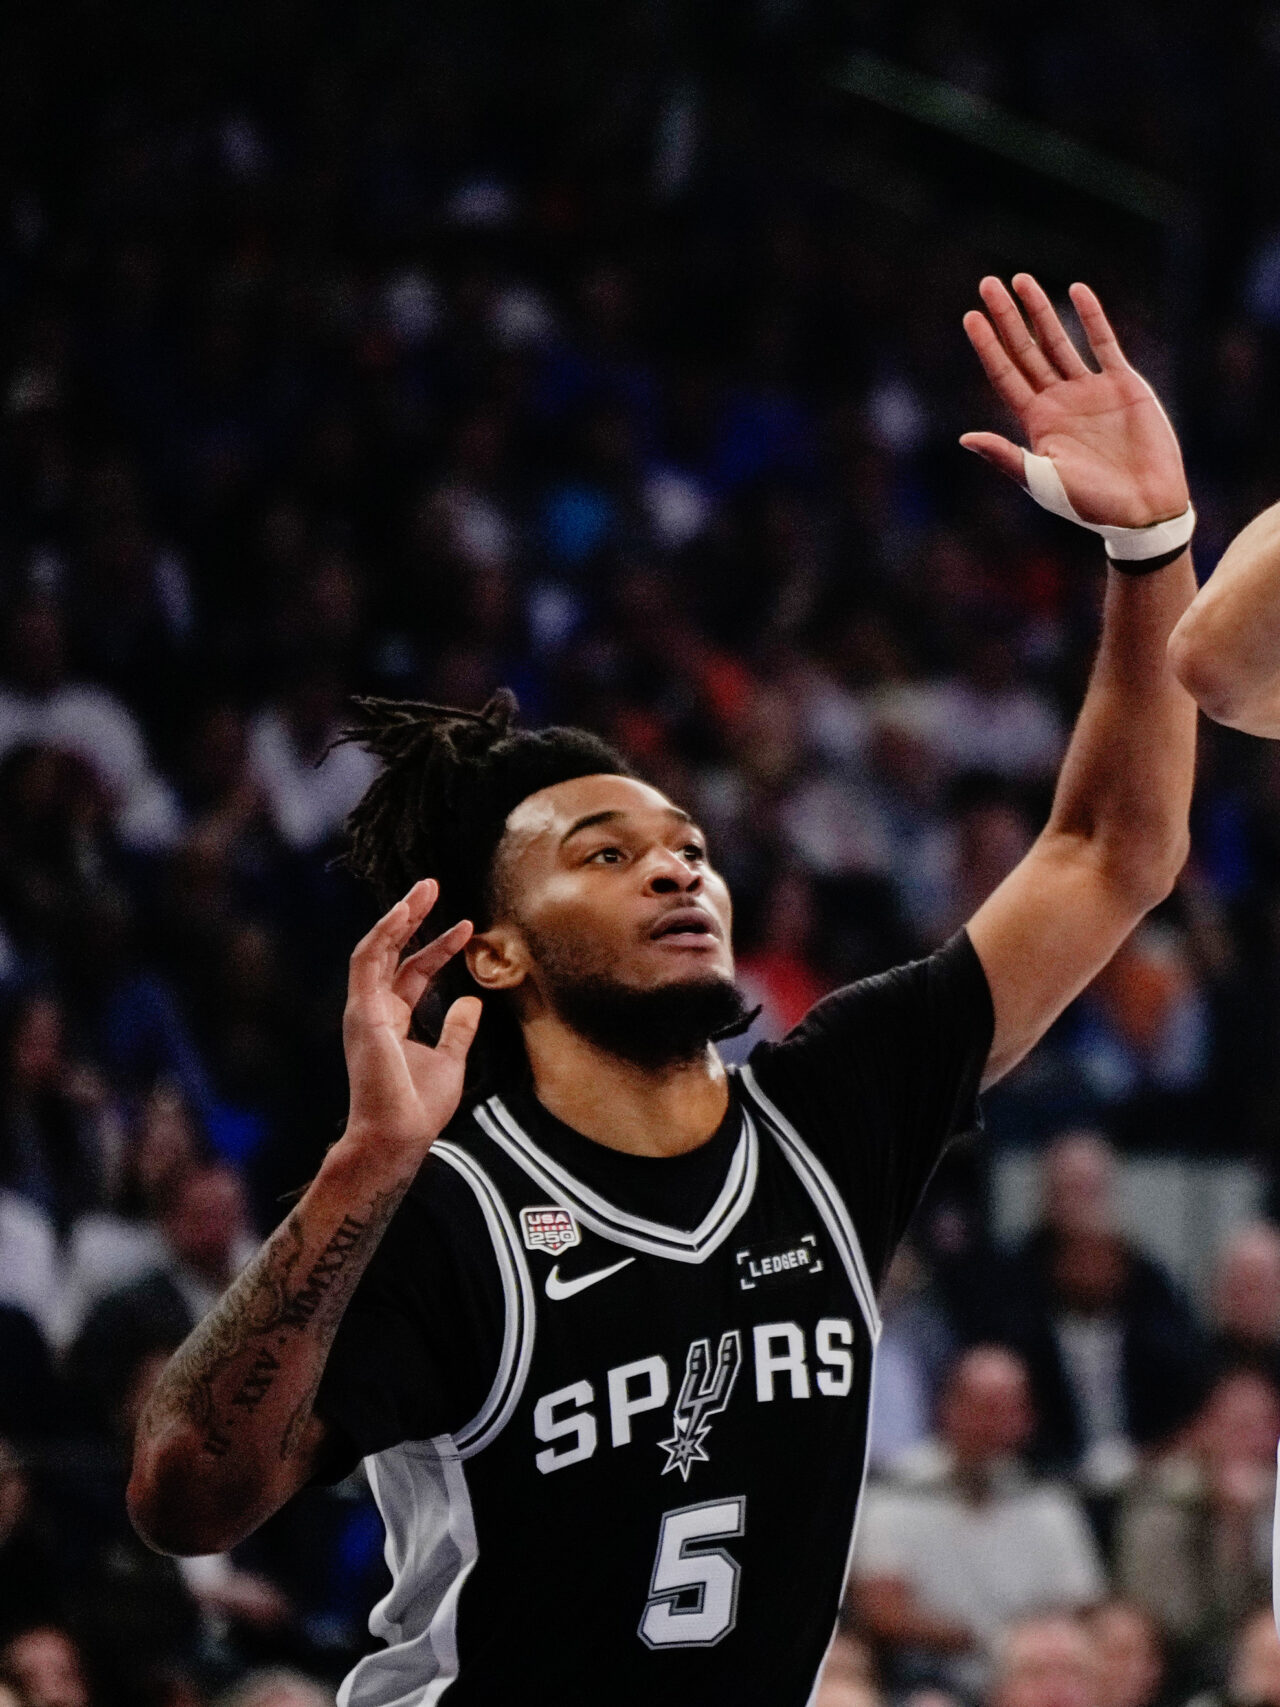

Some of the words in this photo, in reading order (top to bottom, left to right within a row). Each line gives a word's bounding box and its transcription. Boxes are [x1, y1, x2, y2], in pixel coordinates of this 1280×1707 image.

[527, 1213, 568, 1225] USA
[529, 1231, 575, 1244] 250
[748, 1249, 810, 1277] LEDGER
[533, 1318, 854, 1478] SPURS
[636, 1495, 746, 1650] 5
